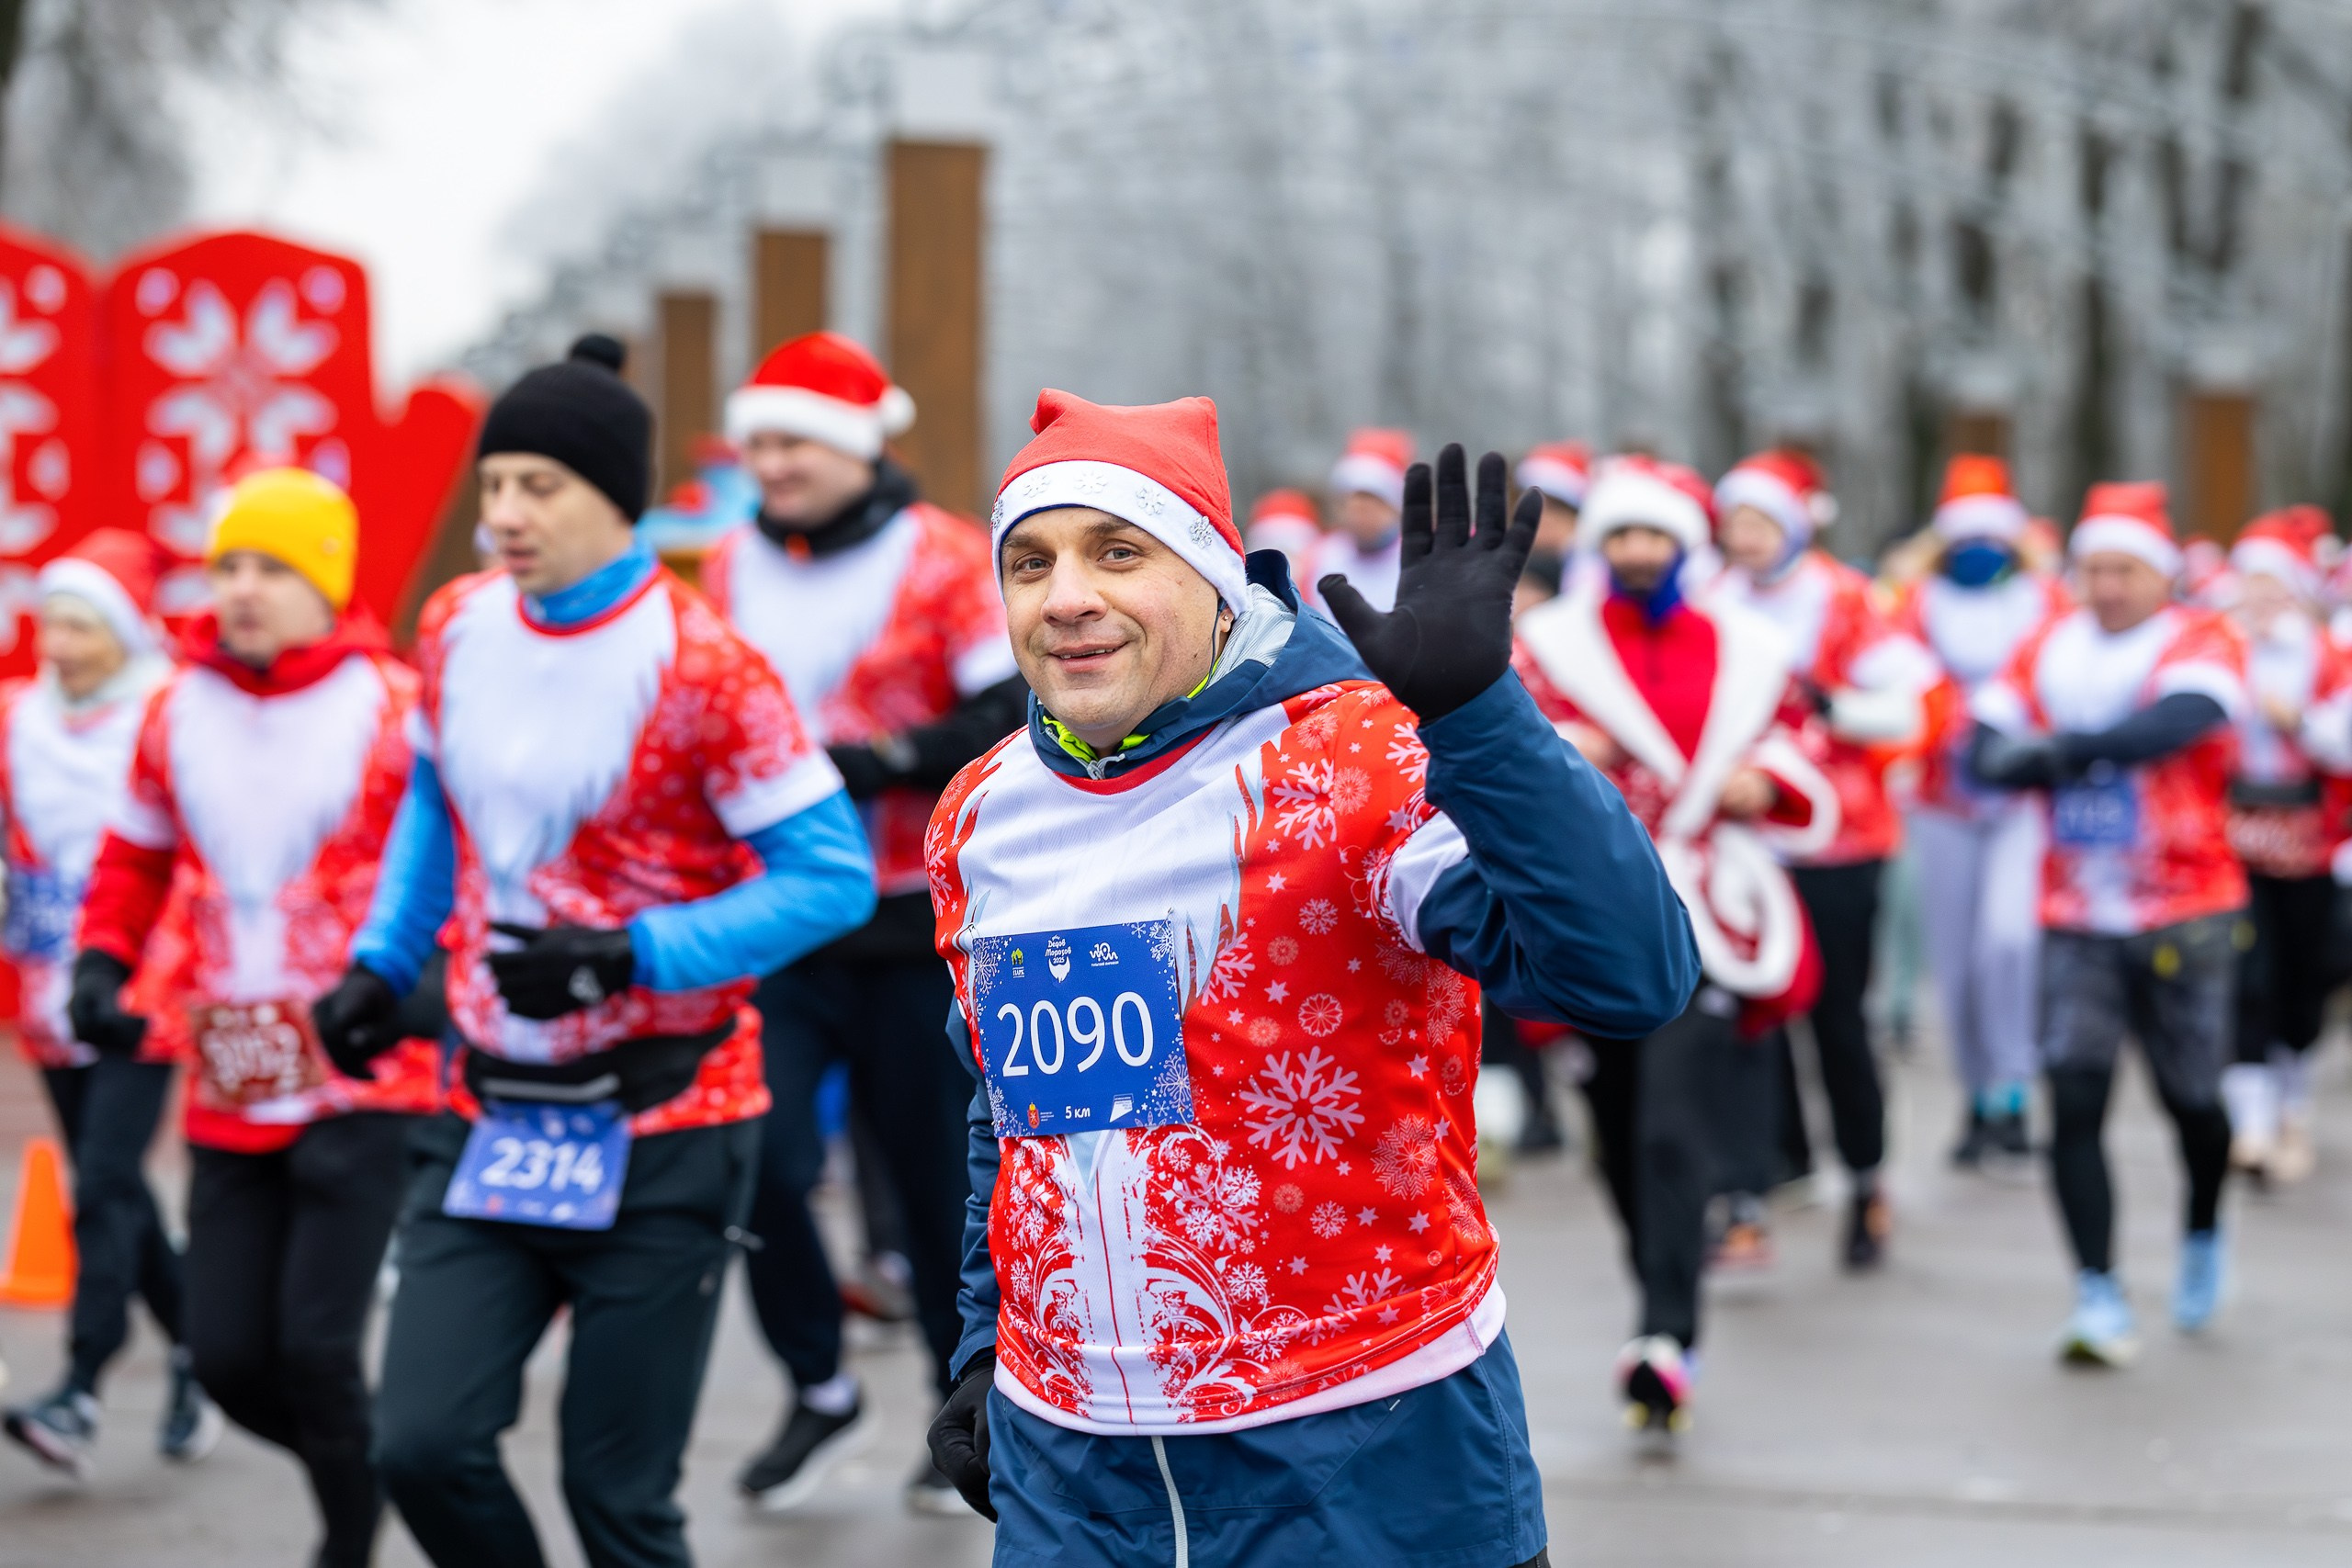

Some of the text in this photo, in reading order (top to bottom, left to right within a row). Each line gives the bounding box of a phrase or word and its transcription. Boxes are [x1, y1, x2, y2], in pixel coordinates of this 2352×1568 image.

[997, 991, 1154, 1077] 2090
[1065, 1105, 1072, 1119] 5
[478, 1136, 605, 1194] 2314
